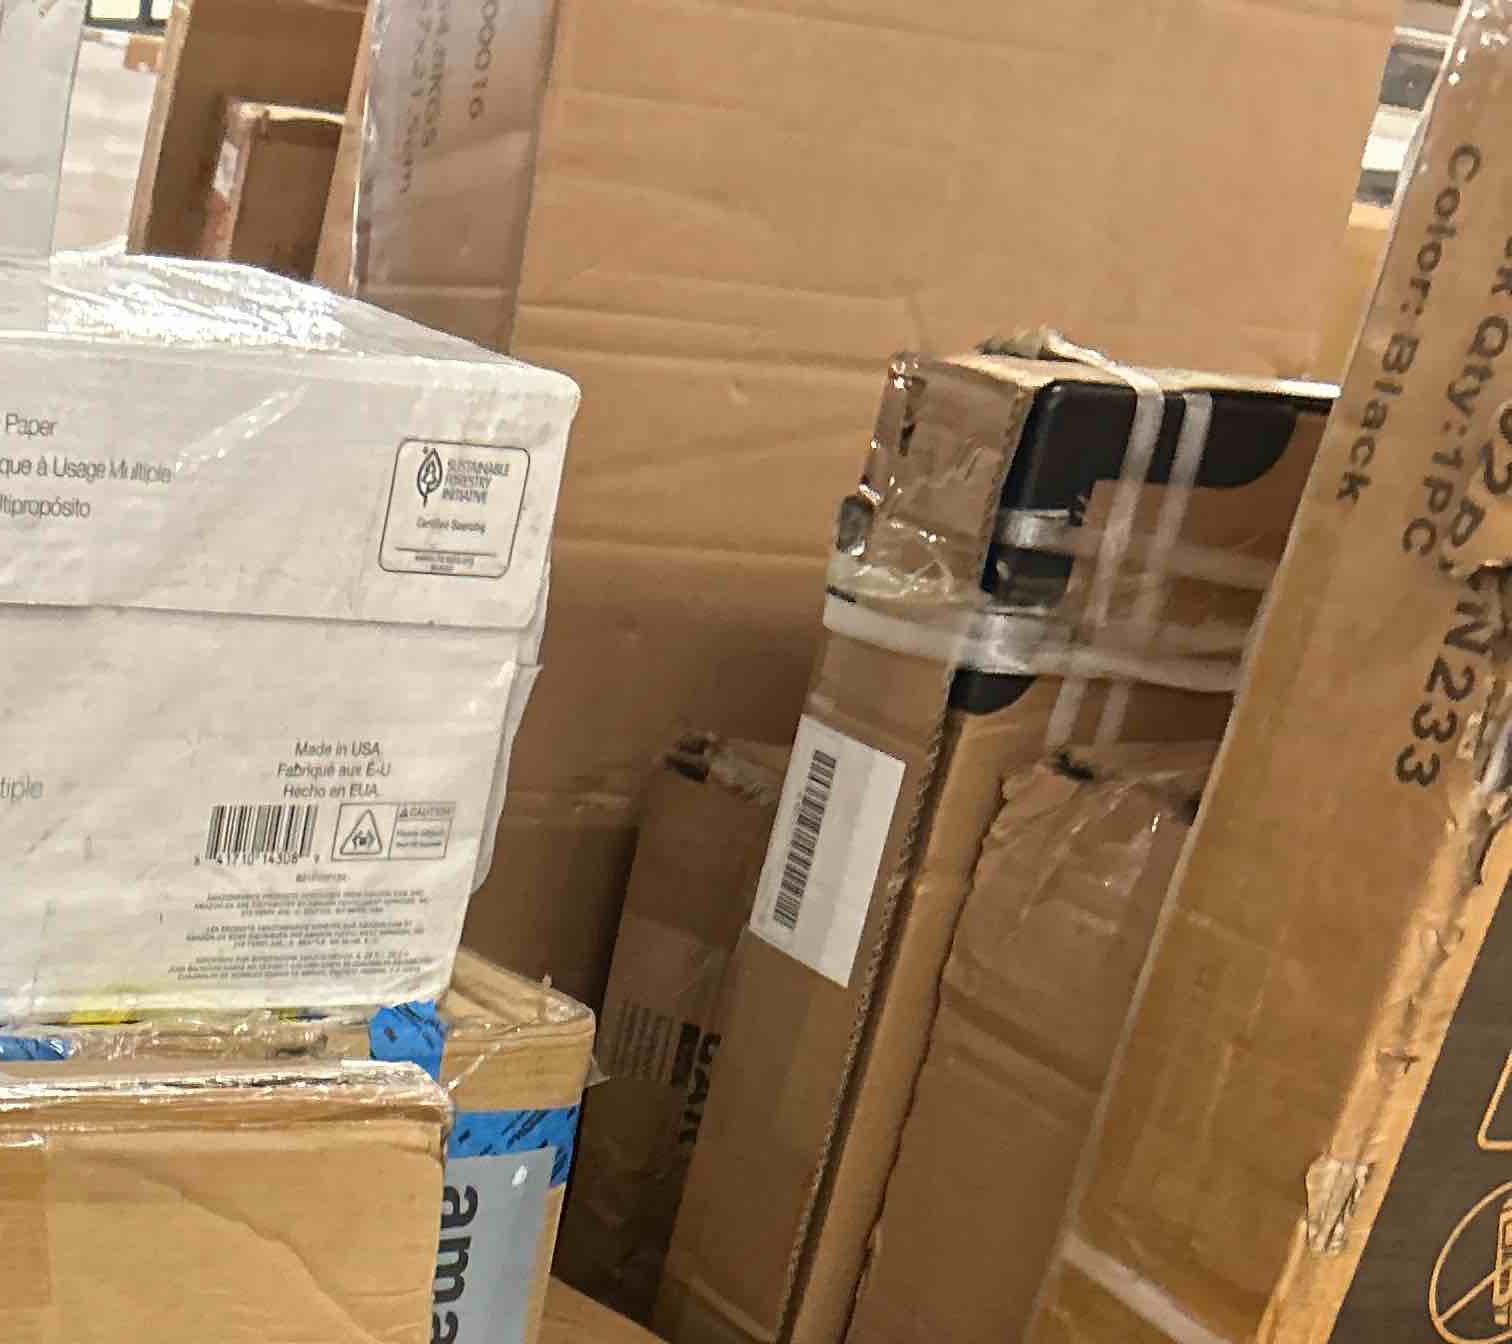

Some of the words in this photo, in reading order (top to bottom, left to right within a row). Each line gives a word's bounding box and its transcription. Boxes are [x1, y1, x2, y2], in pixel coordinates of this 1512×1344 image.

[1401, 144, 1482, 316] Color:
[5, 412, 58, 439] Paper
[1336, 333, 1419, 504] Black
[53, 456, 106, 483] Usage
[109, 458, 173, 485] Multiple
[295, 741, 332, 756] Made
[336, 741, 348, 755] in
[283, 784, 326, 798] Hecho
[329, 786, 346, 797] en
